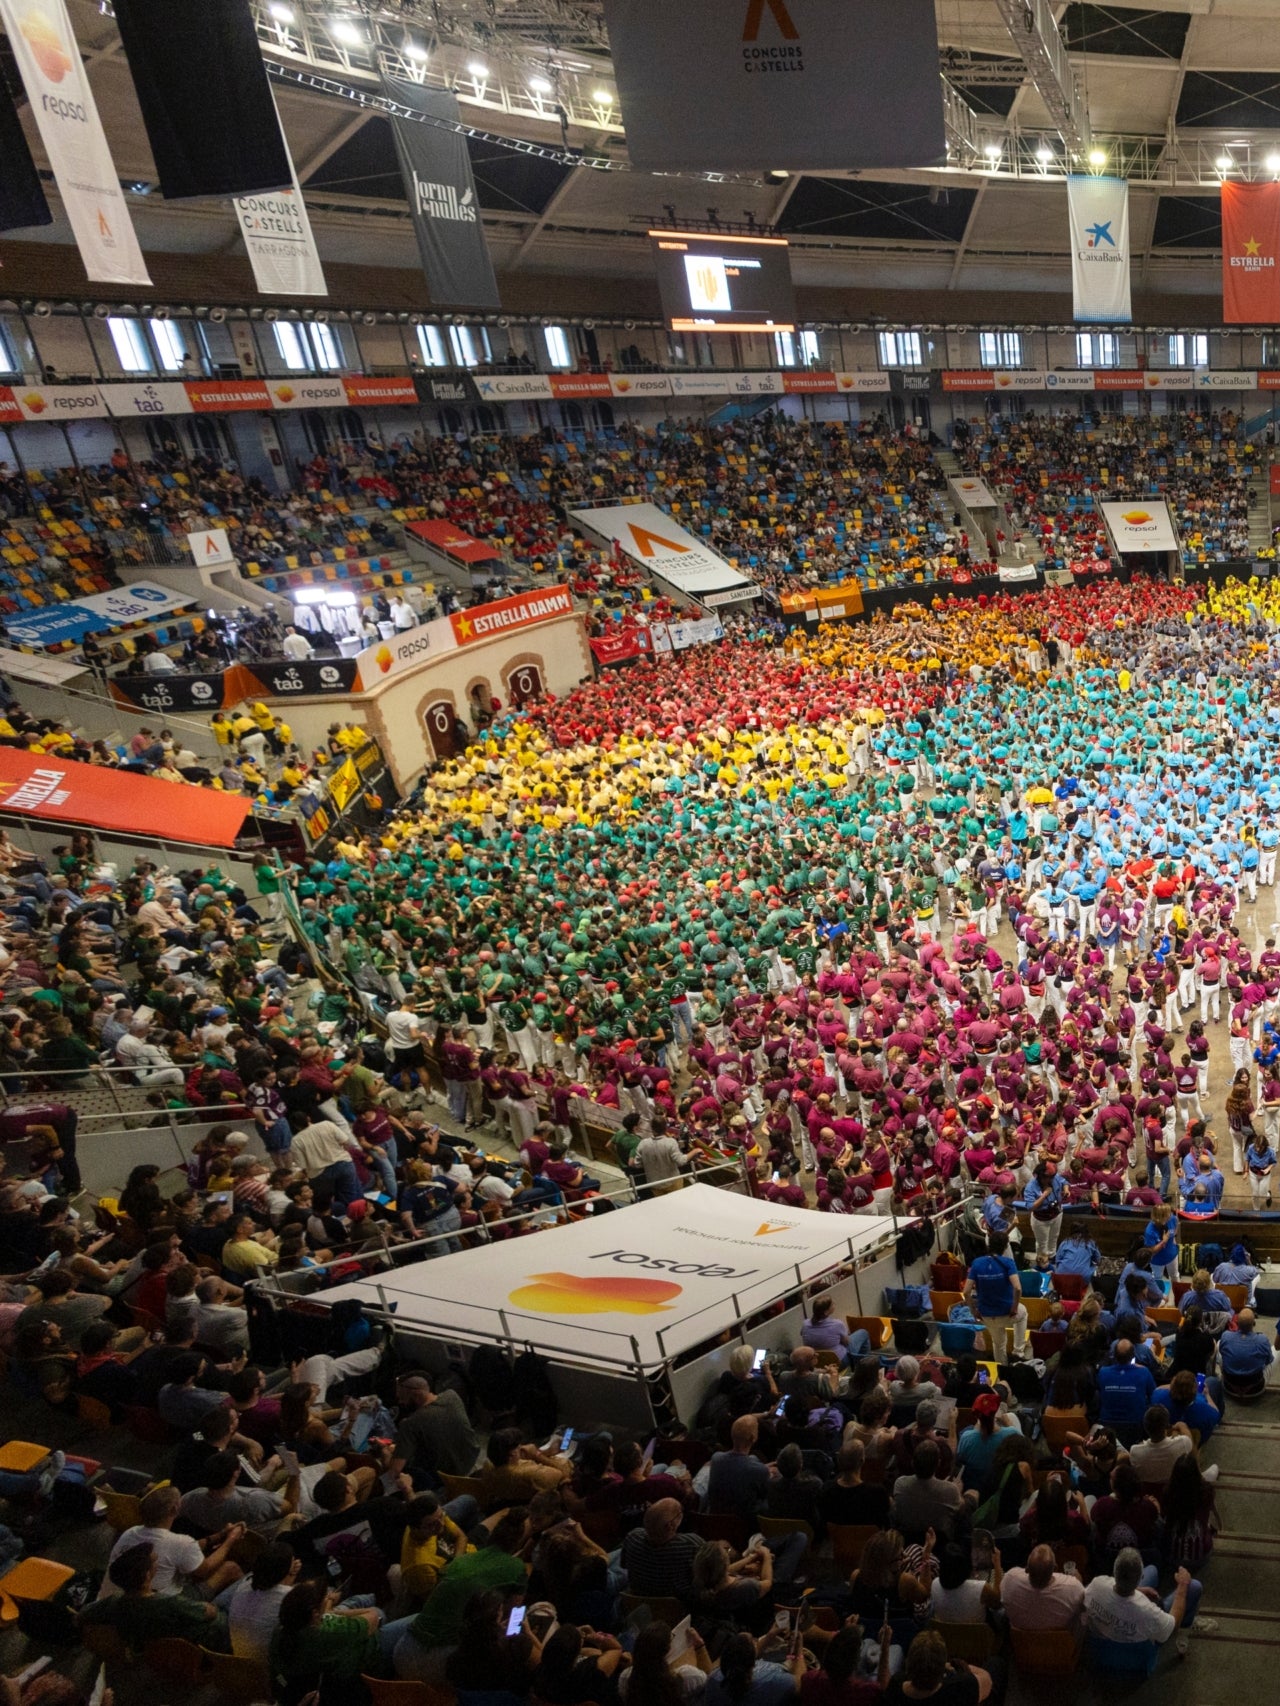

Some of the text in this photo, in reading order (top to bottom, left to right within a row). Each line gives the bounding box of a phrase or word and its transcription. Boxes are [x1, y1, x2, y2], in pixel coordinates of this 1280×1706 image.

[742, 47, 803, 59] CONCURS
[744, 60, 804, 72] CASTELLS
[238, 197, 299, 217] CONCURS
[243, 214, 304, 234] CASTELLS
[250, 241, 311, 258] TARRAGONA
[1078, 251, 1124, 263] CaixaBank
[1230, 257, 1275, 267] ESTRELLA
[635, 380, 667, 391] repsol
[735, 381, 752, 392] tac
[758, 381, 775, 391] tac
[857, 377, 887, 387] repsol
[1015, 376, 1042, 386] repsol
[1058, 376, 1065, 385] la
[1163, 376, 1191, 386] repsol
[1212, 376, 1252, 385] CaixaBank
[301, 387, 341, 400] repsol
[495, 383, 550, 394] CaixaBank
[53, 394, 99, 409] repsol
[201, 392, 241, 402] ESTRELLA
[134, 397, 164, 413] tac
[730, 587, 759, 600] SANITARIS
[106, 603, 149, 617] tac
[473, 593, 570, 634] ESTRELLA DAMM
[398, 633, 430, 660] repsol
[273, 676, 304, 691] tac
[141, 693, 174, 707] tac
[588, 1249, 760, 1279] repsol
